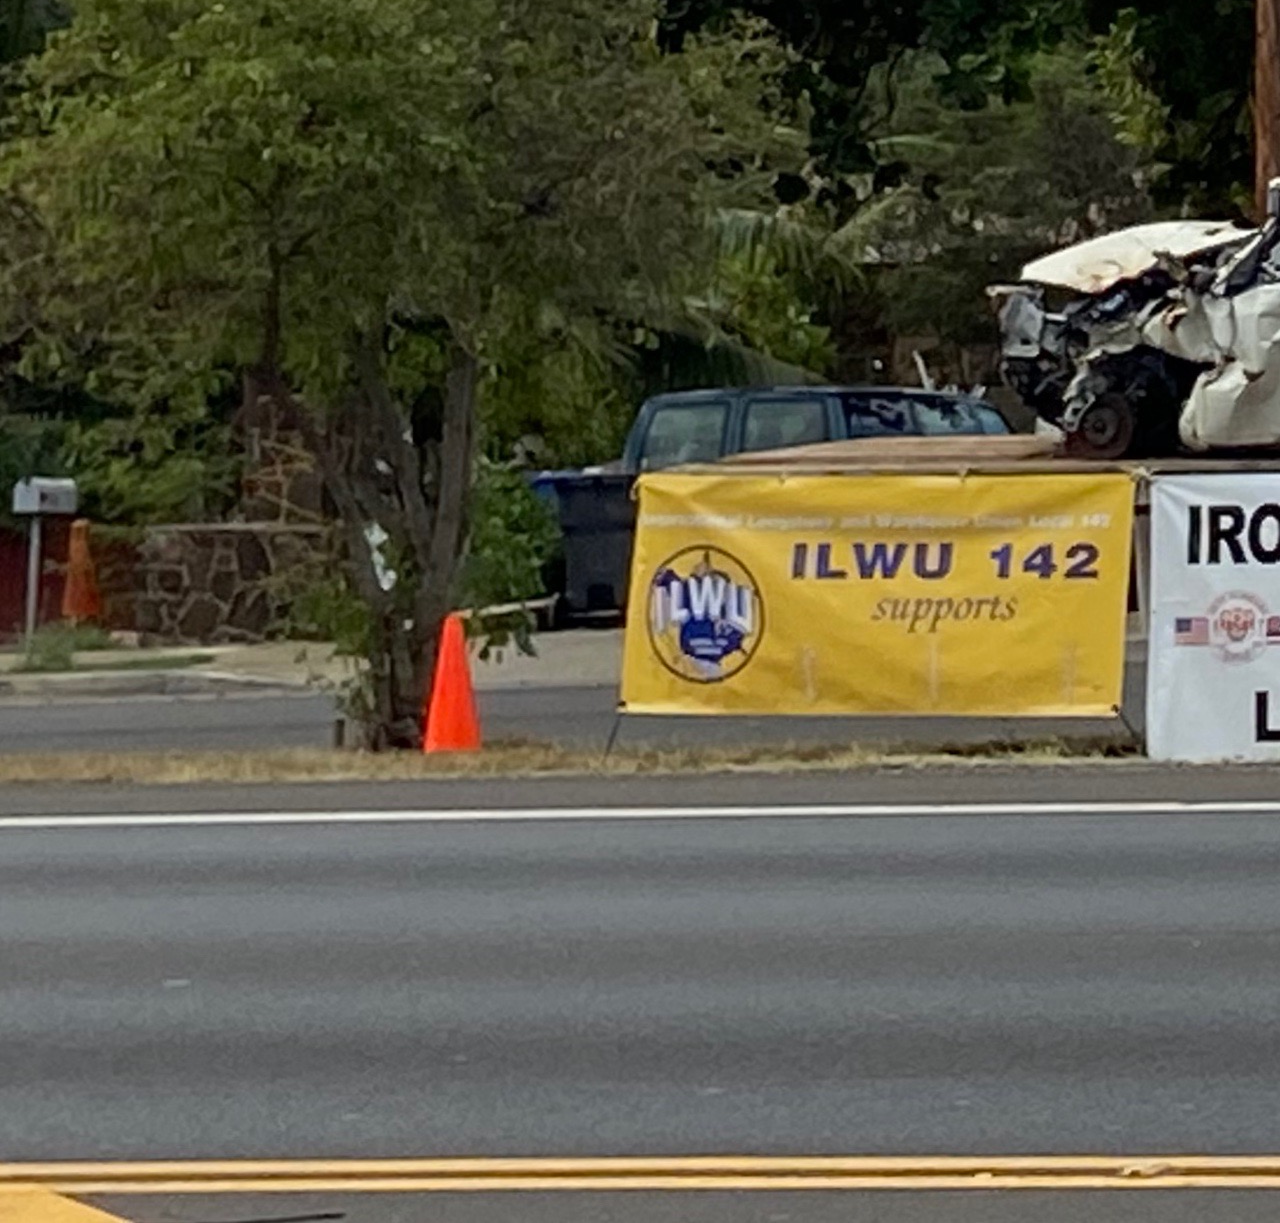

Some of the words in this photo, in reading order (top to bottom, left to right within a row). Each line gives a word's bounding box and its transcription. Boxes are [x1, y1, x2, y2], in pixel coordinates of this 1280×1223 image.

[790, 542, 953, 580] ILWU
[989, 543, 1100, 580] 142
[654, 575, 756, 633] ILWU
[871, 592, 1018, 633] supports
